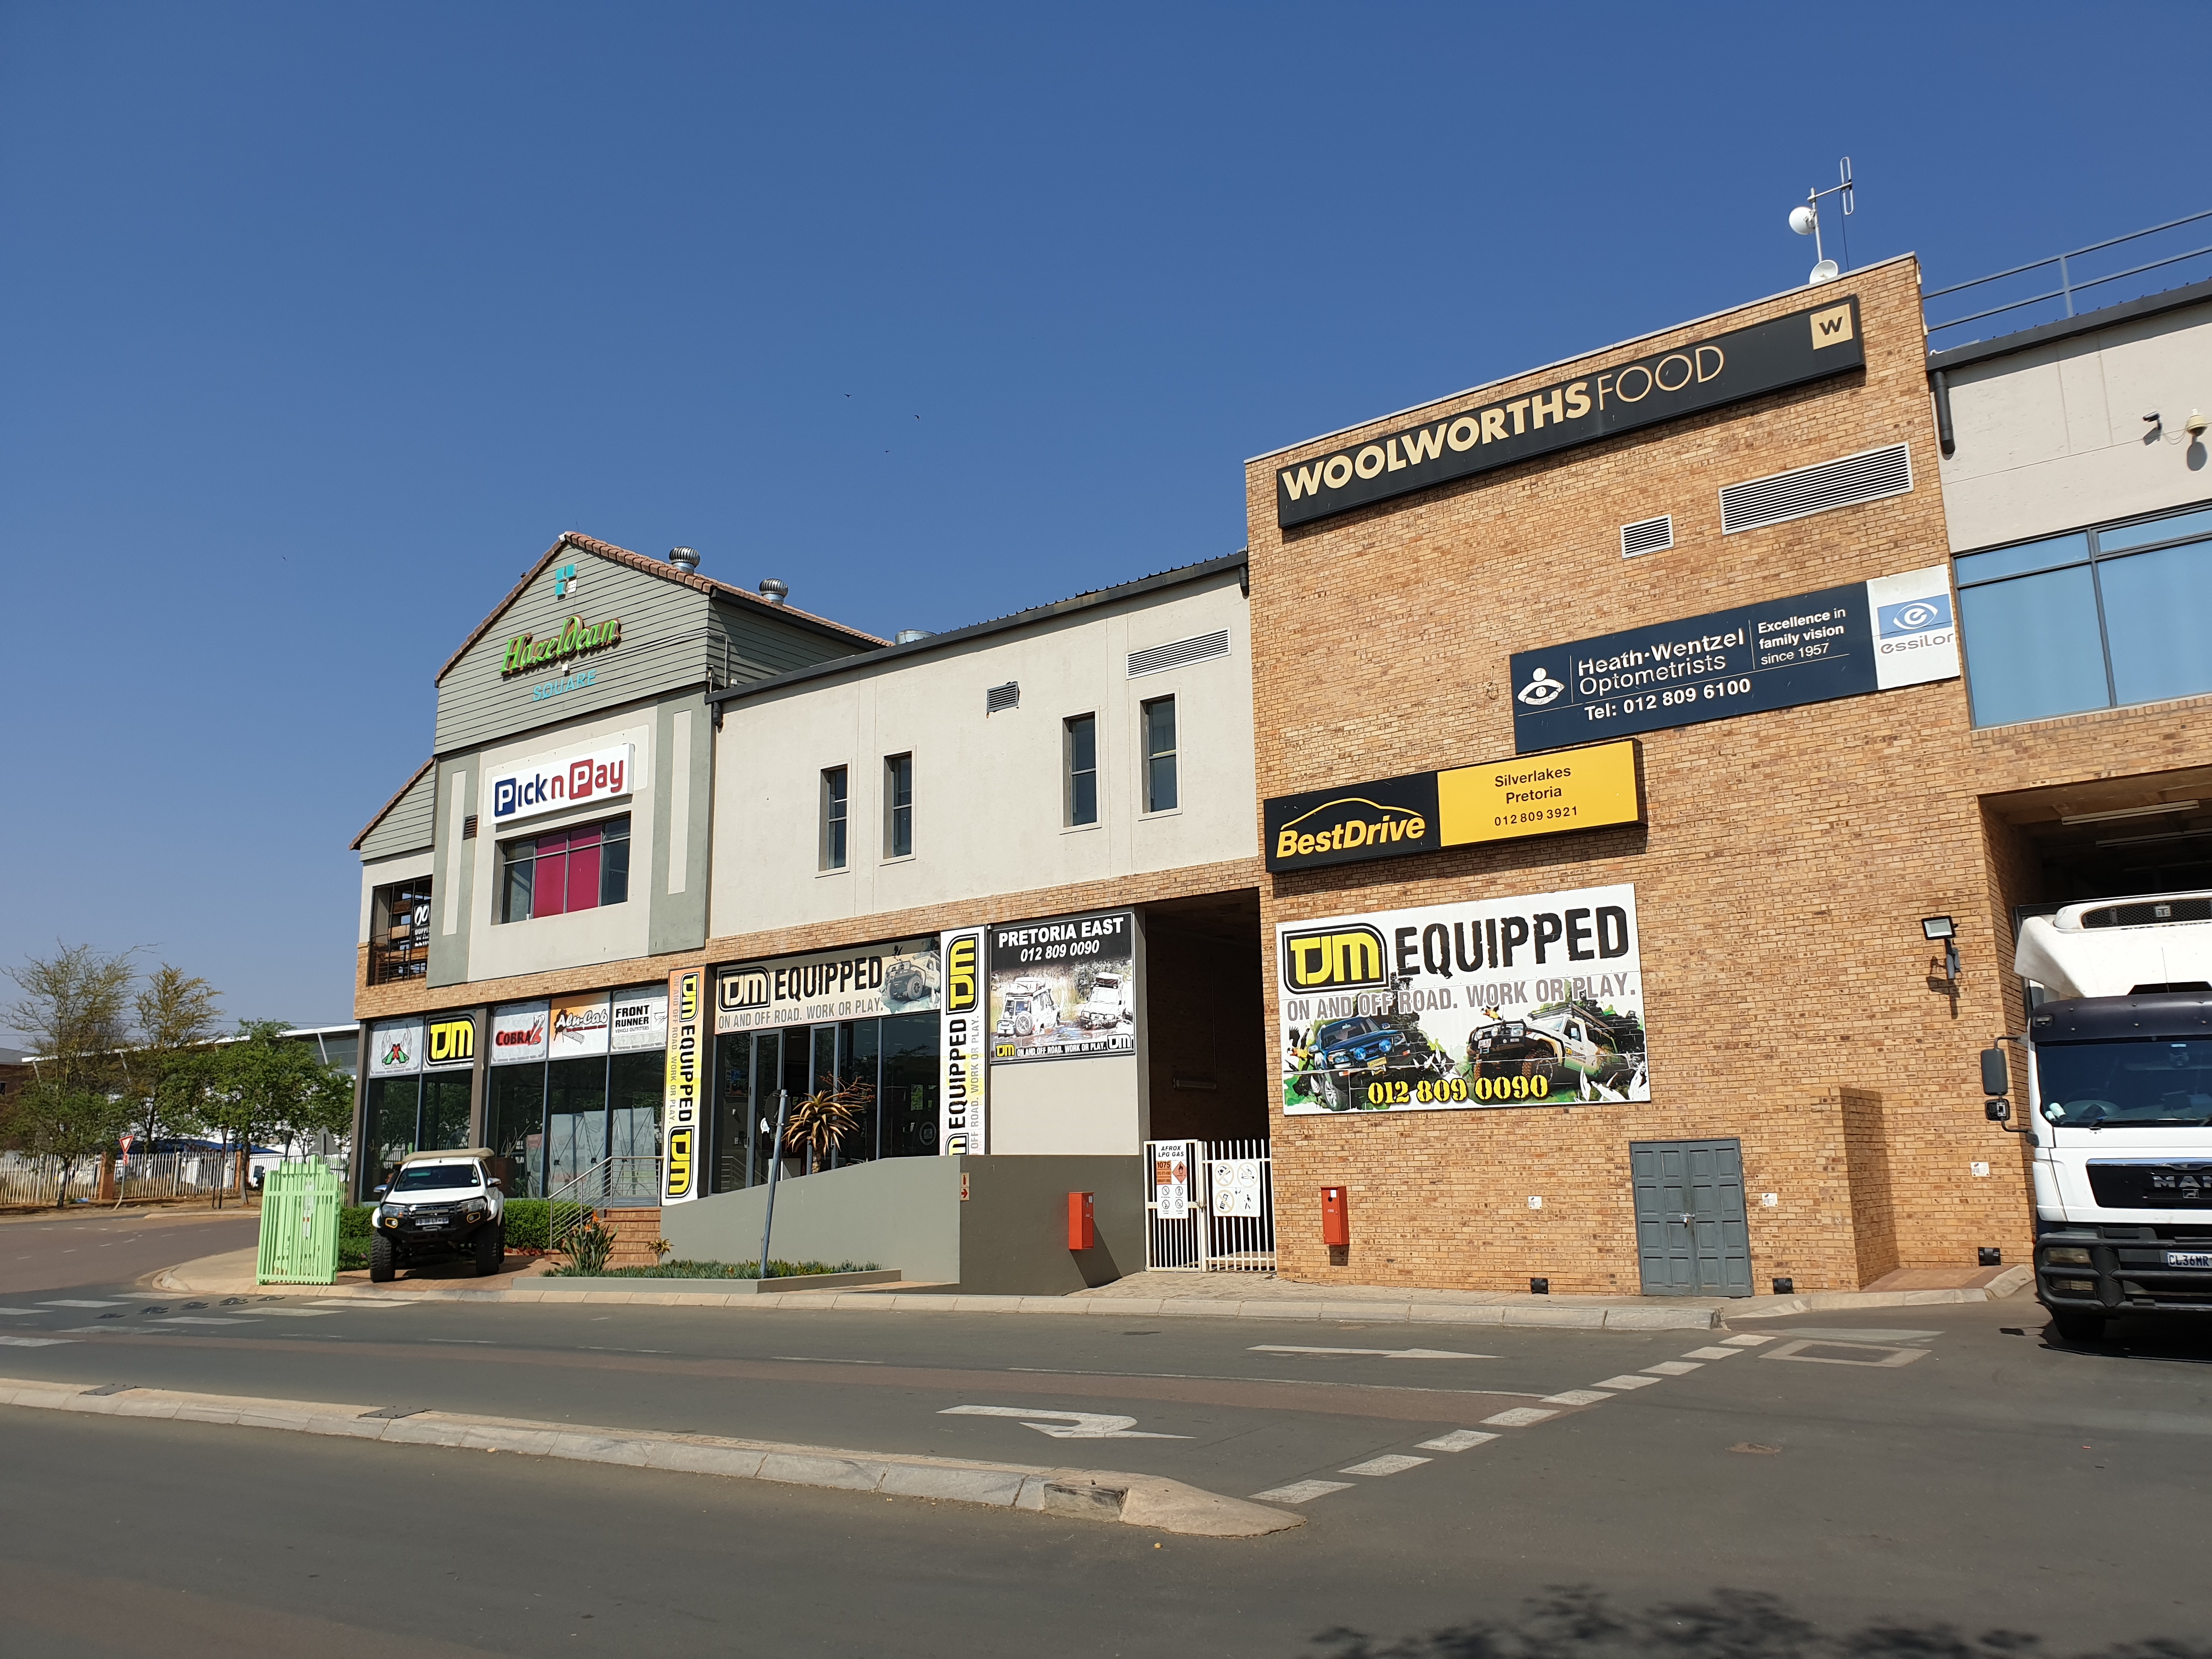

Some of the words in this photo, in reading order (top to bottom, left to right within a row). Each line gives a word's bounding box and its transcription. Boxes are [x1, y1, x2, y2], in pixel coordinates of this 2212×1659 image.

[1281, 381, 1592, 501] WOOLWORTHS
[1597, 346, 1724, 410] FOOD
[1758, 611, 1831, 634] Excellence
[1833, 608, 1846, 619] in
[1758, 633, 1801, 650] family
[1803, 625, 1844, 641] vision
[1760, 650, 1795, 665] since
[1798, 642, 1830, 658] 1957
[532, 669, 597, 701] SQUARE
[1579, 654, 1726, 696] Optometrists
[1584, 702, 1617, 720] Tel:
[1623, 695, 1657, 714] 012
[1662, 687, 1697, 706] 809
[1703, 678, 1751, 699] 6100
[495, 773, 548, 816] Pick
[551, 775, 565, 799] n
[569, 759, 624, 799] Pay
[1494, 768, 1571, 787] Silverlakes
[1506, 786, 1562, 804] Pretoria
[1494, 814, 1517, 826] 012
[1520, 810, 1543, 823] 809
[1546, 805, 1577, 819] 3921
[1276, 815, 1425, 858] BestDrive
[998, 923, 1077, 948] PRETORIA
[1081, 917, 1124, 938] EAST
[1290, 932, 1380, 985] TJM
[1395, 906, 1629, 979] EQUIPPED
[1020, 946, 1043, 962] 012
[1045, 944, 1067, 960] 809
[1069, 939, 1100, 956] 0090
[673, 975, 680, 986] ON
[722, 973, 768, 1007] TJM
[774, 955, 883, 1002] EQUIPPED
[950, 939, 975, 1009] TJM
[615, 1005, 650, 1018] FRONT
[681, 975, 698, 1020] TJM
[1286, 999, 1310, 1022] ON
[1316, 996, 1352, 1019] AND
[1358, 993, 1393, 1015] OFF
[1399, 988, 1458, 1013] ROAD.
[1465, 981, 1528, 1008] WORK
[1536, 978, 1564, 1002] OR
[1572, 973, 1636, 1000] PLAY.
[555, 1008, 608, 1028] Alu-Cab
[615, 1017, 649, 1028] RUNNER
[719, 1015, 731, 1029] ON
[733, 1012, 752, 1028] AND
[754, 1011, 771, 1026] OFF
[774, 1007, 803, 1024] ROAD.
[806, 1002, 835, 1020] WORK
[838, 1001, 851, 1017] OR
[855, 997, 884, 1014] PLAY.
[430, 1020, 473, 1059] TJM
[495, 1030, 531, 1046] COBRA
[971, 1015, 979, 1043] PLAY.
[970, 1047, 979, 1060] OR
[996, 1043, 1015, 1057] TJM
[1017, 1048, 1024, 1057] ON
[1025, 1047, 1036, 1056] AND
[1037, 1046, 1046, 1056] OFF
[1047, 1045, 1063, 1054] ROAD.
[1064, 1043, 1081, 1053] WORK
[1081, 1043, 1090, 1052] OR
[1090, 1042, 1106, 1051] PLAY.
[678, 1024, 696, 1122] EQUIPPED
[949, 1019, 968, 1129] EQUIPPED
[970, 1063, 979, 1093] WORK
[670, 1084, 676, 1097] OR
[1368, 1080, 1411, 1104] 012
[1416, 1077, 1468, 1102] 809
[1475, 1074, 1549, 1100] 0090
[970, 1097, 979, 1127] ROAD.
[970, 1131, 979, 1149] OFF
[668, 1130, 691, 1194] TJM
